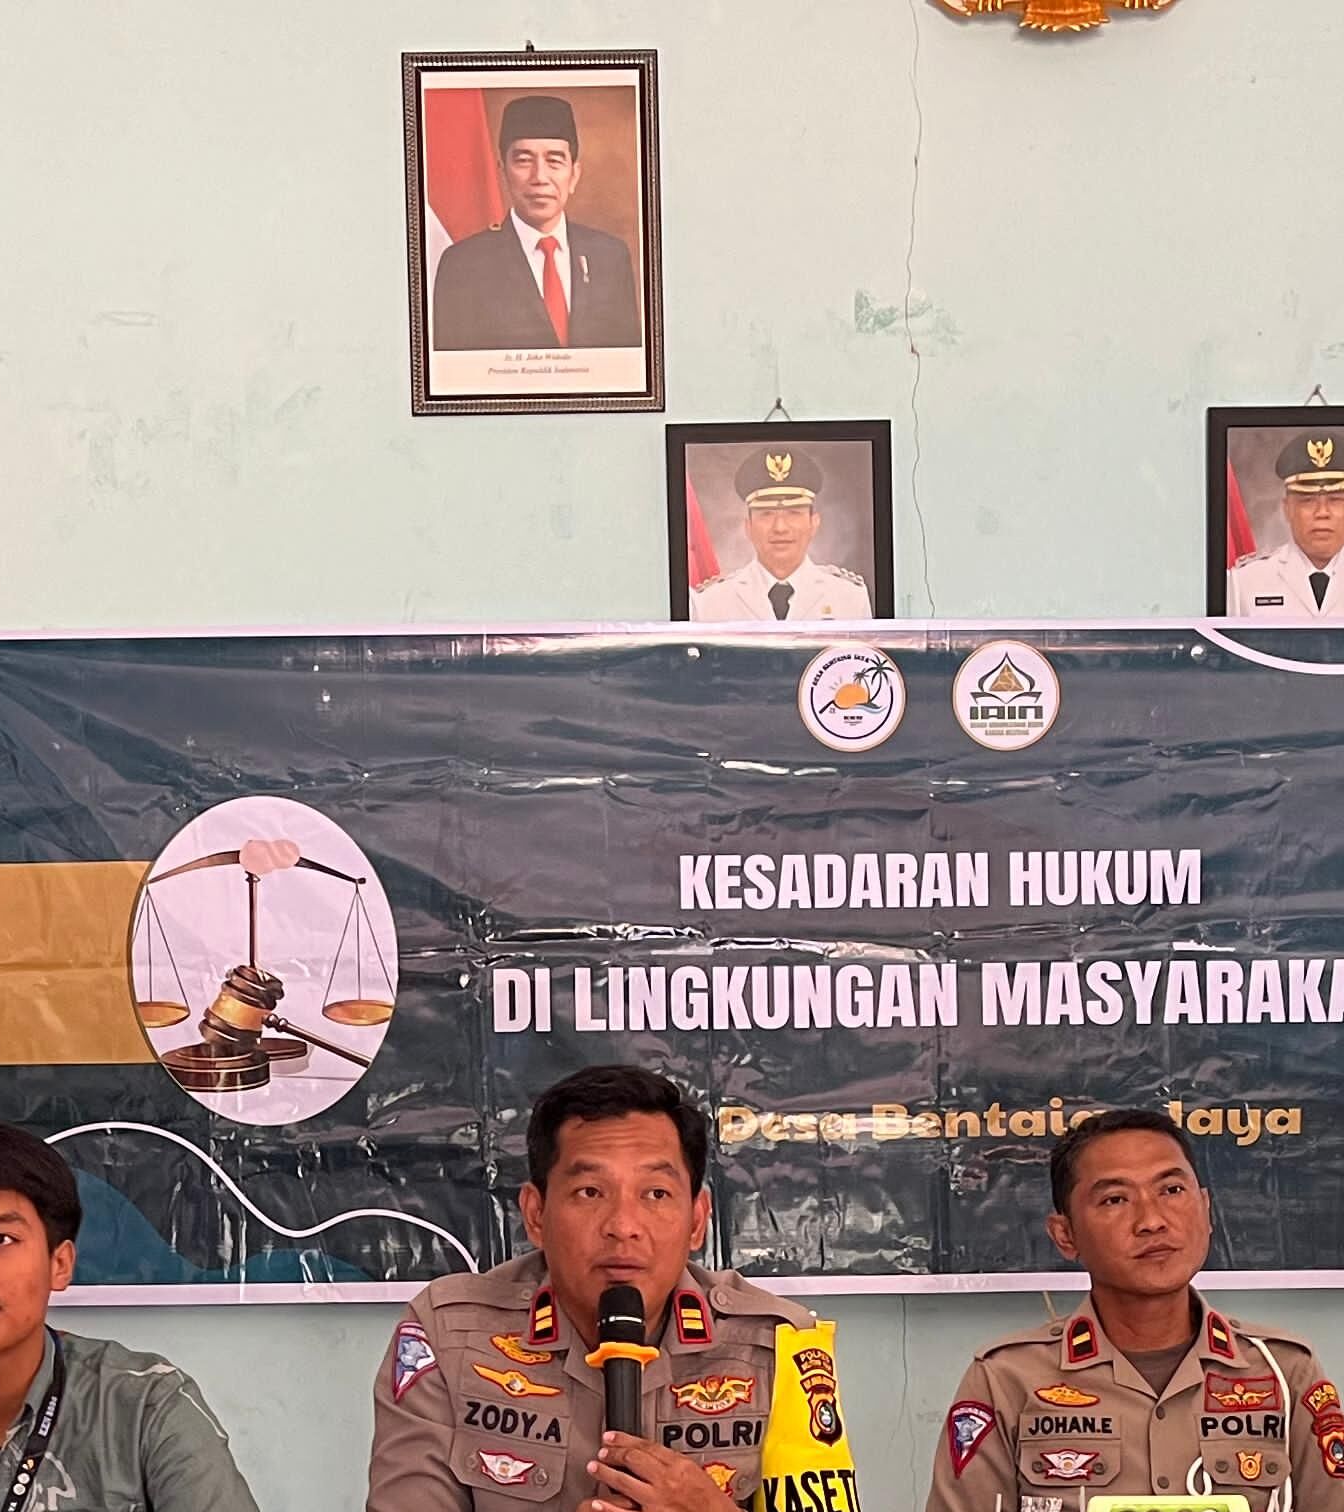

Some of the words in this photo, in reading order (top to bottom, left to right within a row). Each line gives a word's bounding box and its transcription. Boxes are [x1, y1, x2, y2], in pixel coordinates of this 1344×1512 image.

[970, 706, 1043, 719] IAIN
[680, 853, 988, 911] KESADARAN
[1010, 849, 1202, 907] HUKUM
[493, 967, 552, 1032] DI
[575, 962, 958, 1032] LINGKUNGAN
[718, 1105, 857, 1142] Desa
[464, 1401, 561, 1442] ZODY.A
[663, 1421, 762, 1449] POLRI
[1028, 1416, 1113, 1435] JOHAN.E
[1201, 1414, 1285, 1438] POLRI
